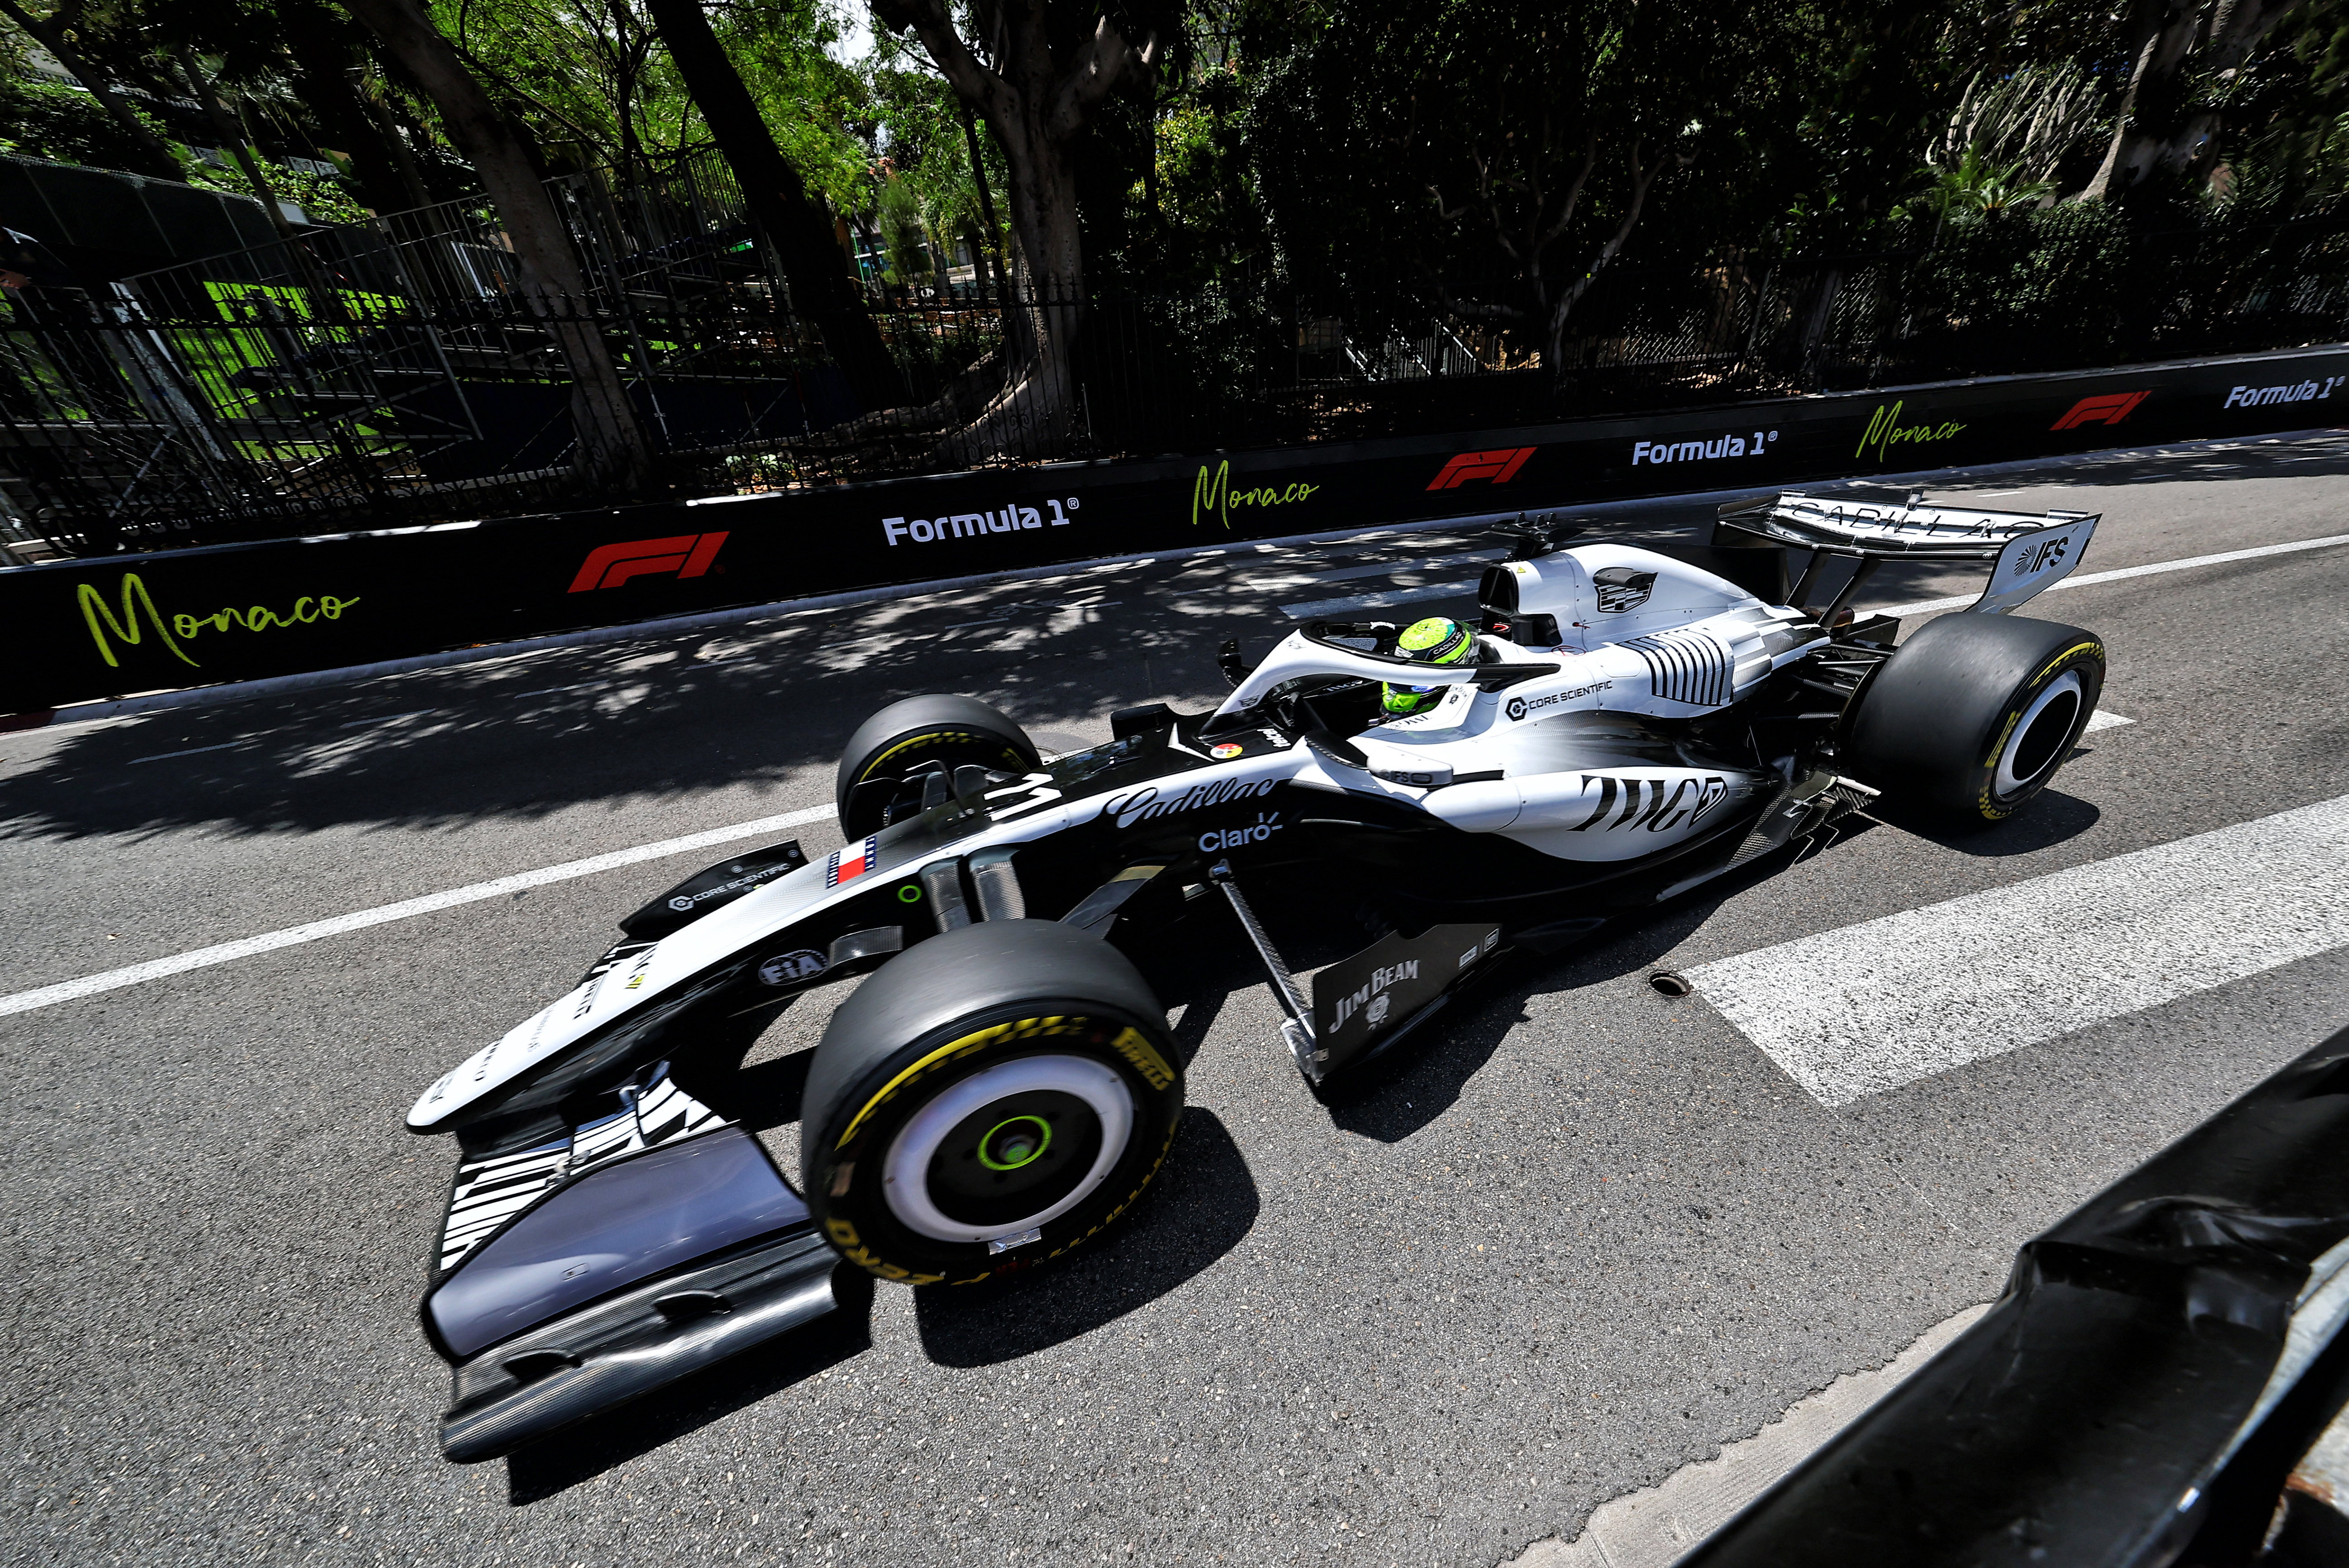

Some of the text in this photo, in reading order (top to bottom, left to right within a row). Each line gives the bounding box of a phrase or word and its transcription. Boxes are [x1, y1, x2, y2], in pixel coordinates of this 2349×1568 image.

[2224, 379, 2319, 409] Formula
[1632, 434, 1745, 465] Formula
[1855, 400, 1967, 462] Monaco
[1192, 460, 1320, 529] Monaco
[882, 504, 1042, 546] Formula
[2030, 536, 2069, 573] IFS
[77, 573, 361, 667] Monaco
[1433, 632, 1462, 655] CADILLAC
[1529, 680, 1613, 710] CORE SCIENTIFIC
[1256, 728, 1291, 748] telcel
[983, 773, 1063, 822] 11
[1103, 777, 1279, 829] Cadillac
[864, 837, 875, 869] TOMMY
[1198, 823, 1272, 852] Claro
[692, 863, 791, 901] CORE SCIENTIFIC
[1328, 959, 1421, 1034] JIM BEAM
